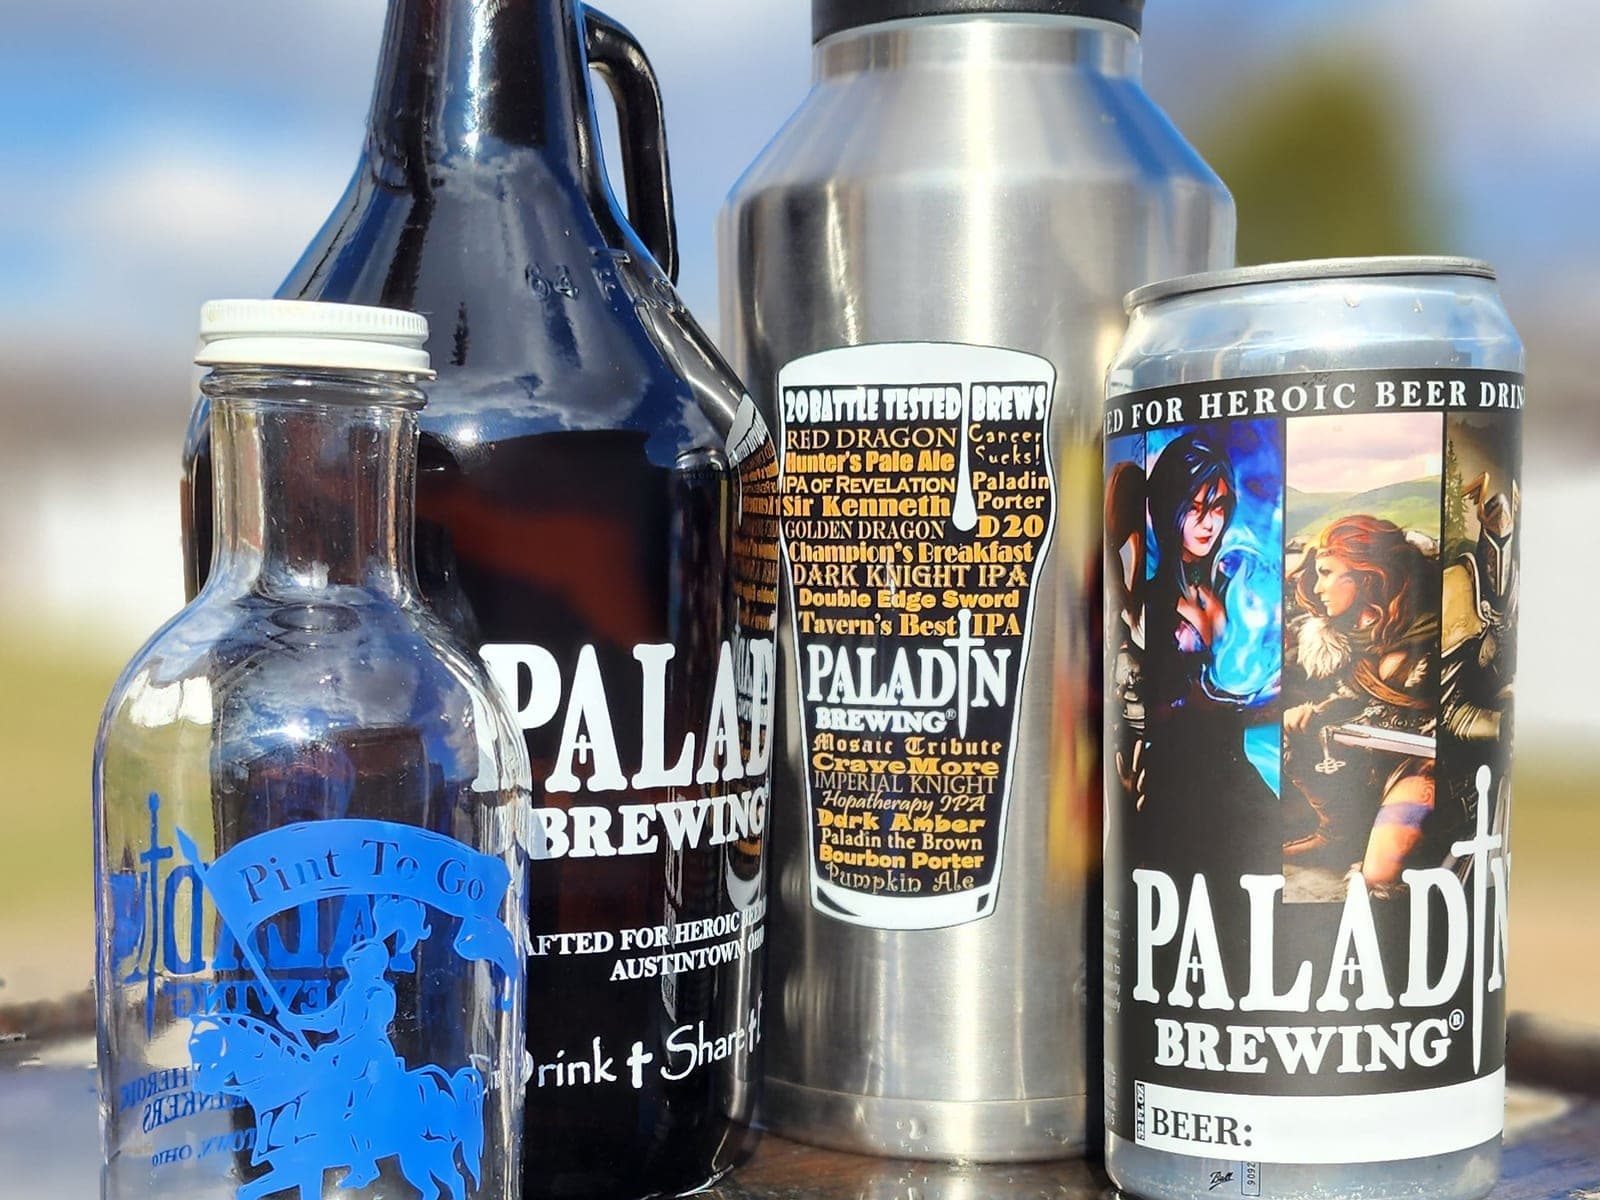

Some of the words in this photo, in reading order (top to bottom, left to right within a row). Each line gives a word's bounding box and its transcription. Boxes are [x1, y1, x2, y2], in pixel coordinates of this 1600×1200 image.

[809, 387, 879, 422] BATTLE
[883, 388, 961, 421] TESTED
[971, 385, 1046, 421] BREWS
[1131, 397, 1184, 430] FOR
[1199, 383, 1357, 420] HEROIC
[1375, 381, 1467, 408] BEER
[786, 429, 830, 450] RED
[836, 426, 958, 449] DRAGON
[968, 423, 1041, 444] Cancer
[786, 451, 859, 473] Hunter's
[866, 450, 913, 472] Pale
[918, 450, 955, 472] Ale
[975, 444, 1040, 466] Sucks!
[783, 476, 808, 494] IPA
[812, 478, 832, 493] OF
[972, 471, 1050, 490] Paladin
[783, 496, 814, 518] Sir
[822, 496, 950, 517] Kenneth
[978, 491, 1045, 510] Porter
[785, 520, 852, 540] GOLDEN
[857, 520, 945, 540] DRAGON
[789, 541, 913, 564] Champion's
[918, 541, 1034, 563] Breakfast
[793, 564, 862, 588] DARK
[867, 564, 970, 588] KNIGHT
[979, 565, 1028, 588] IPA
[799, 588, 871, 608] Double
[877, 589, 936, 612] Edge
[942, 590, 1019, 609] Sword
[798, 611, 892, 637] Tavern's
[898, 613, 958, 637] Best
[972, 613, 1022, 637] IPA
[812, 733, 893, 755] Mosaic
[904, 736, 1002, 756] Tribute
[814, 771, 903, 793] IMPERIAL
[910, 775, 997, 795] KNIGHT
[822, 789, 934, 819] Hopatherapy
[940, 794, 986, 812] IPA
[529, 787, 768, 860] BREWING
[817, 808, 879, 831] Dark
[889, 813, 987, 833] Amber
[821, 828, 882, 849] Paladin
[888, 830, 916, 850] the
[923, 832, 983, 851] Brown
[819, 845, 905, 868] Bourbon
[912, 852, 984, 870] Porter
[238, 847, 344, 904] Pint
[361, 839, 419, 881] To
[436, 858, 484, 901] Go
[825, 862, 921, 894] Pumpkin
[932, 871, 975, 893] Ale
[620, 924, 671, 951] FOR
[674, 911, 740, 945] HEROIC
[660, 1020, 745, 1080] Share
[1151, 1107, 1252, 1147] BEER:
